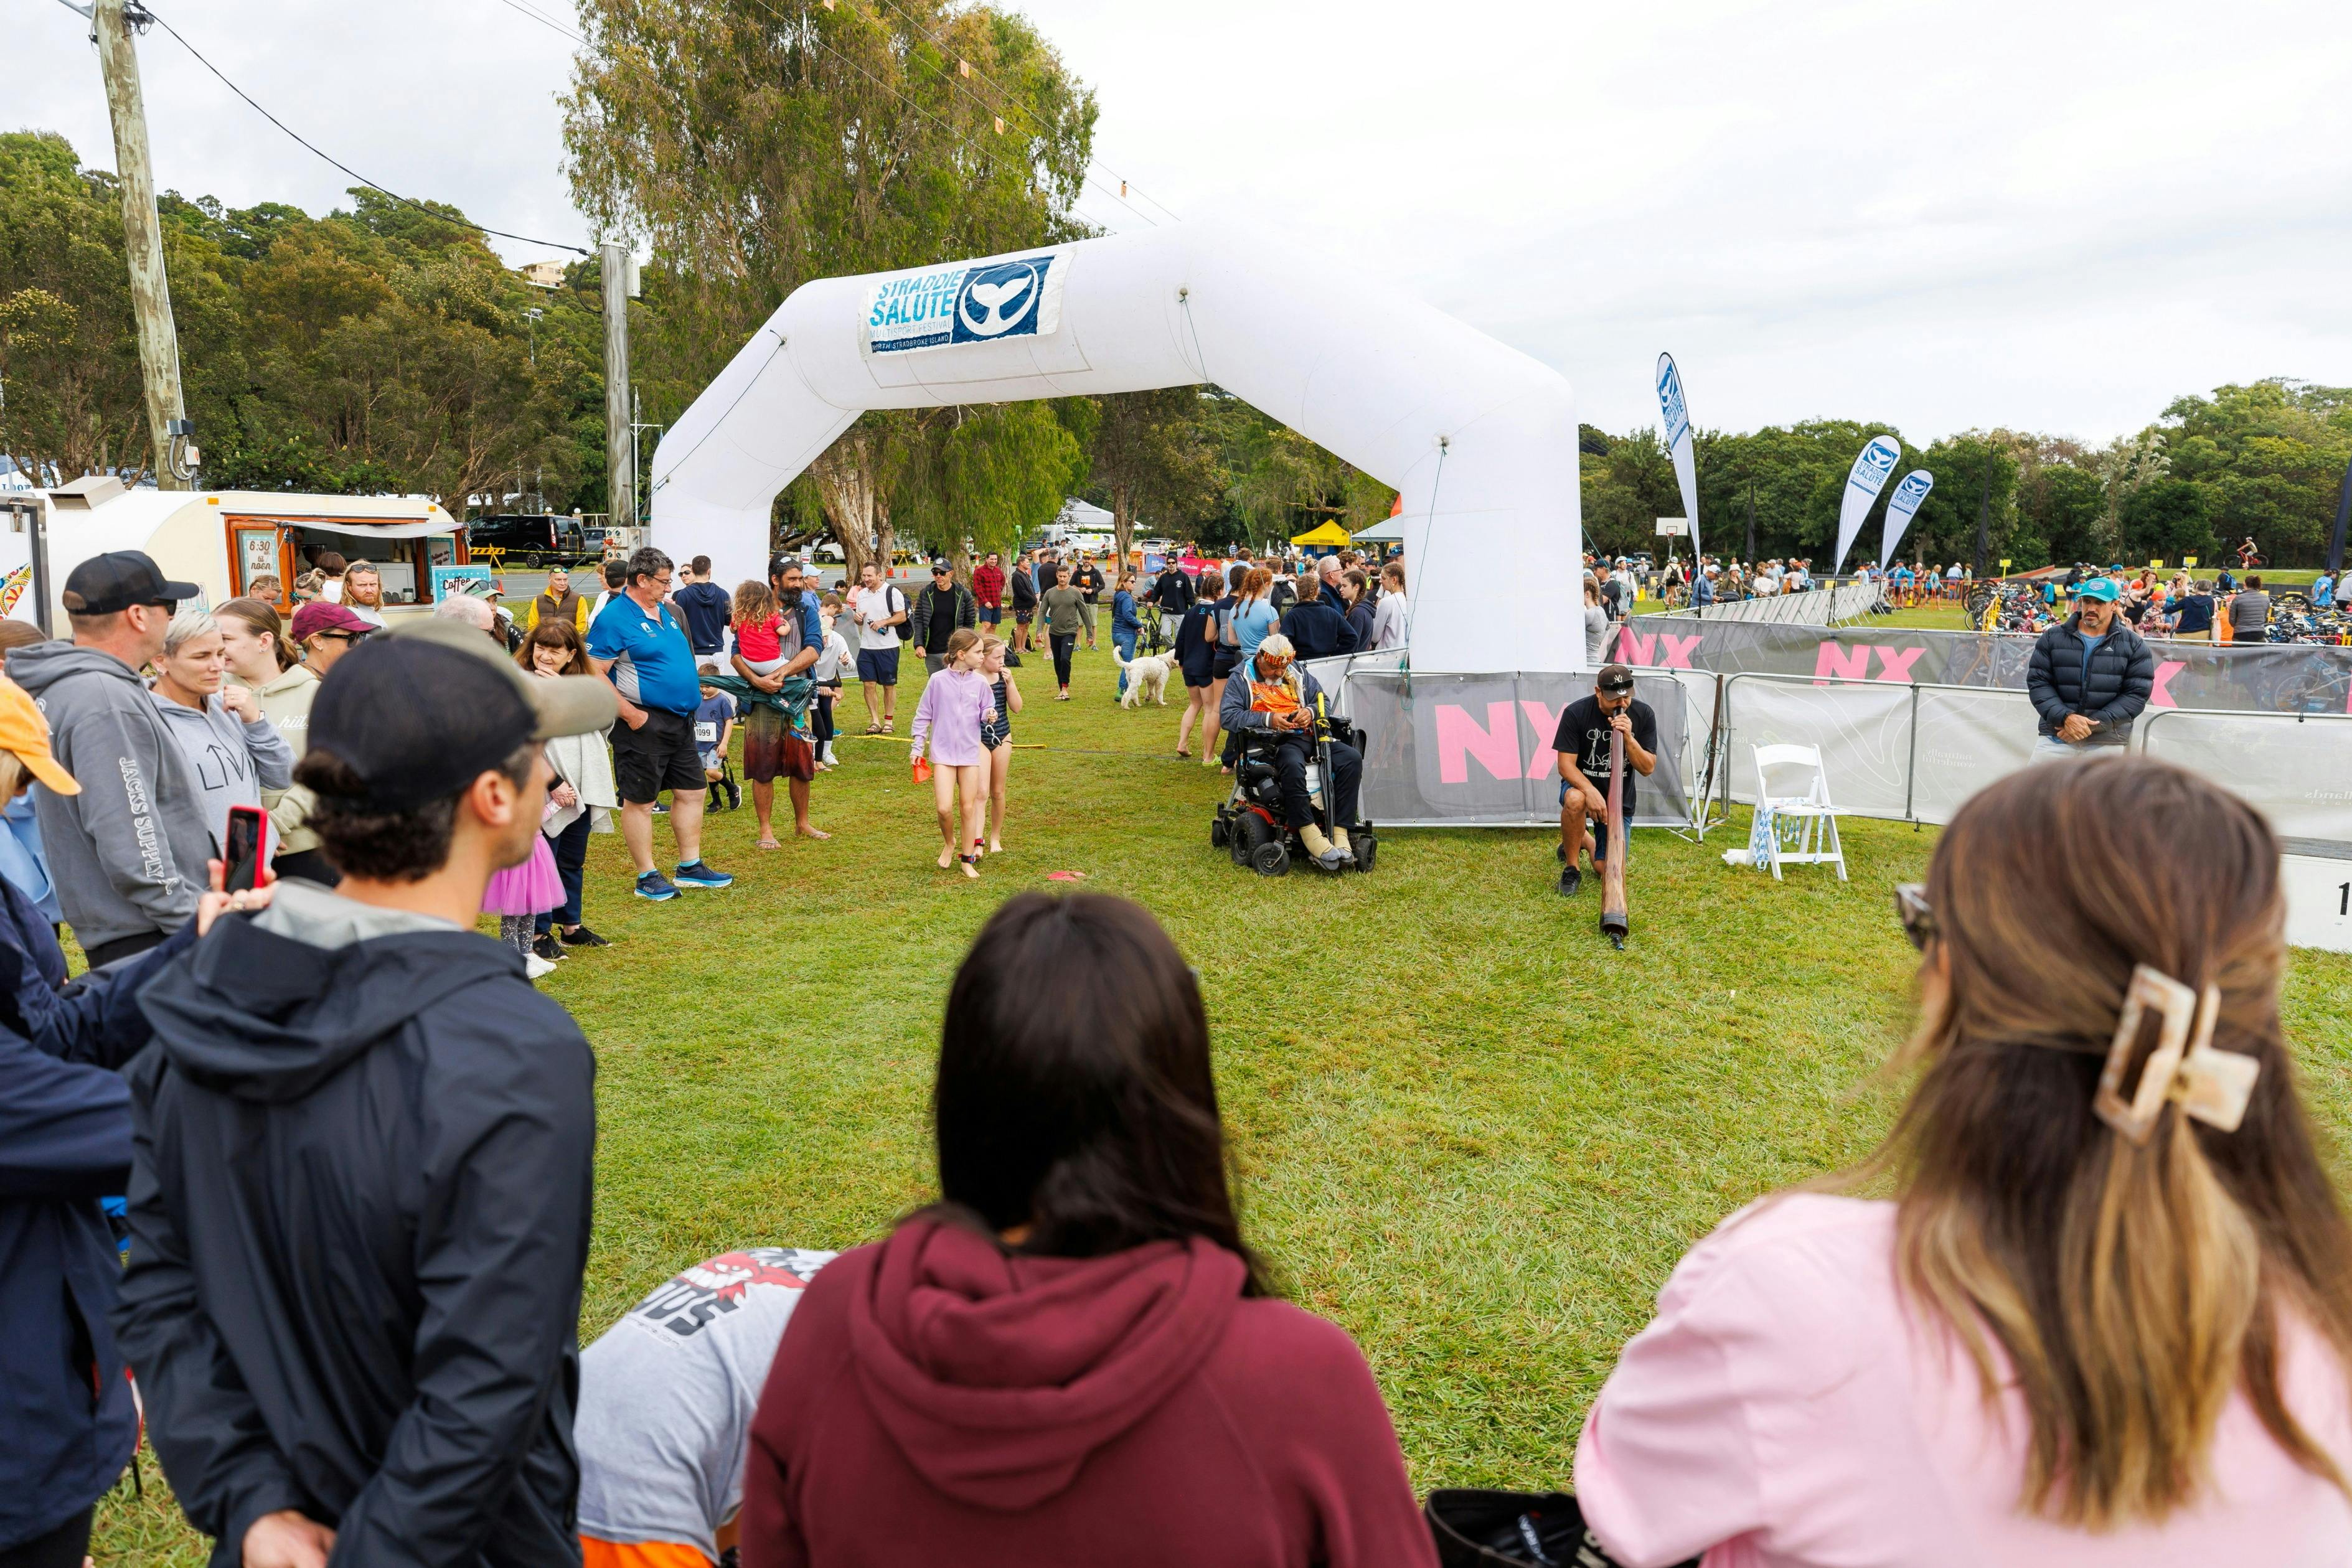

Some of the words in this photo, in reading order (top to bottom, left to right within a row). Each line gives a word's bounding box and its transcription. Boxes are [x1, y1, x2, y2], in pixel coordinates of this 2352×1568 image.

[878, 270, 966, 299] STRADDIE
[870, 289, 956, 326] SALUTE
[869, 325, 916, 339] MULTISPORT
[919, 318, 951, 332] FESTIVAL
[892, 338, 928, 349] STRADBROKE
[929, 334, 949, 344] ISLAND
[1855, 466, 1884, 486] SALUTE
[1859, 461, 1886, 479] STRADDIE
[1894, 494, 1918, 508] SALUTE
[1898, 489, 1921, 503] STRADDIE
[443, 576, 471, 593] Coffee
[1614, 626, 1705, 669] NX
[1813, 641, 1926, 685] NX
[697, 728, 710, 736] 1099
[1435, 700, 1571, 784] NX
[119, 757, 149, 815] JACKS
[134, 816, 164, 878] SUPPLY
[2339, 882, 2350, 916] 1
